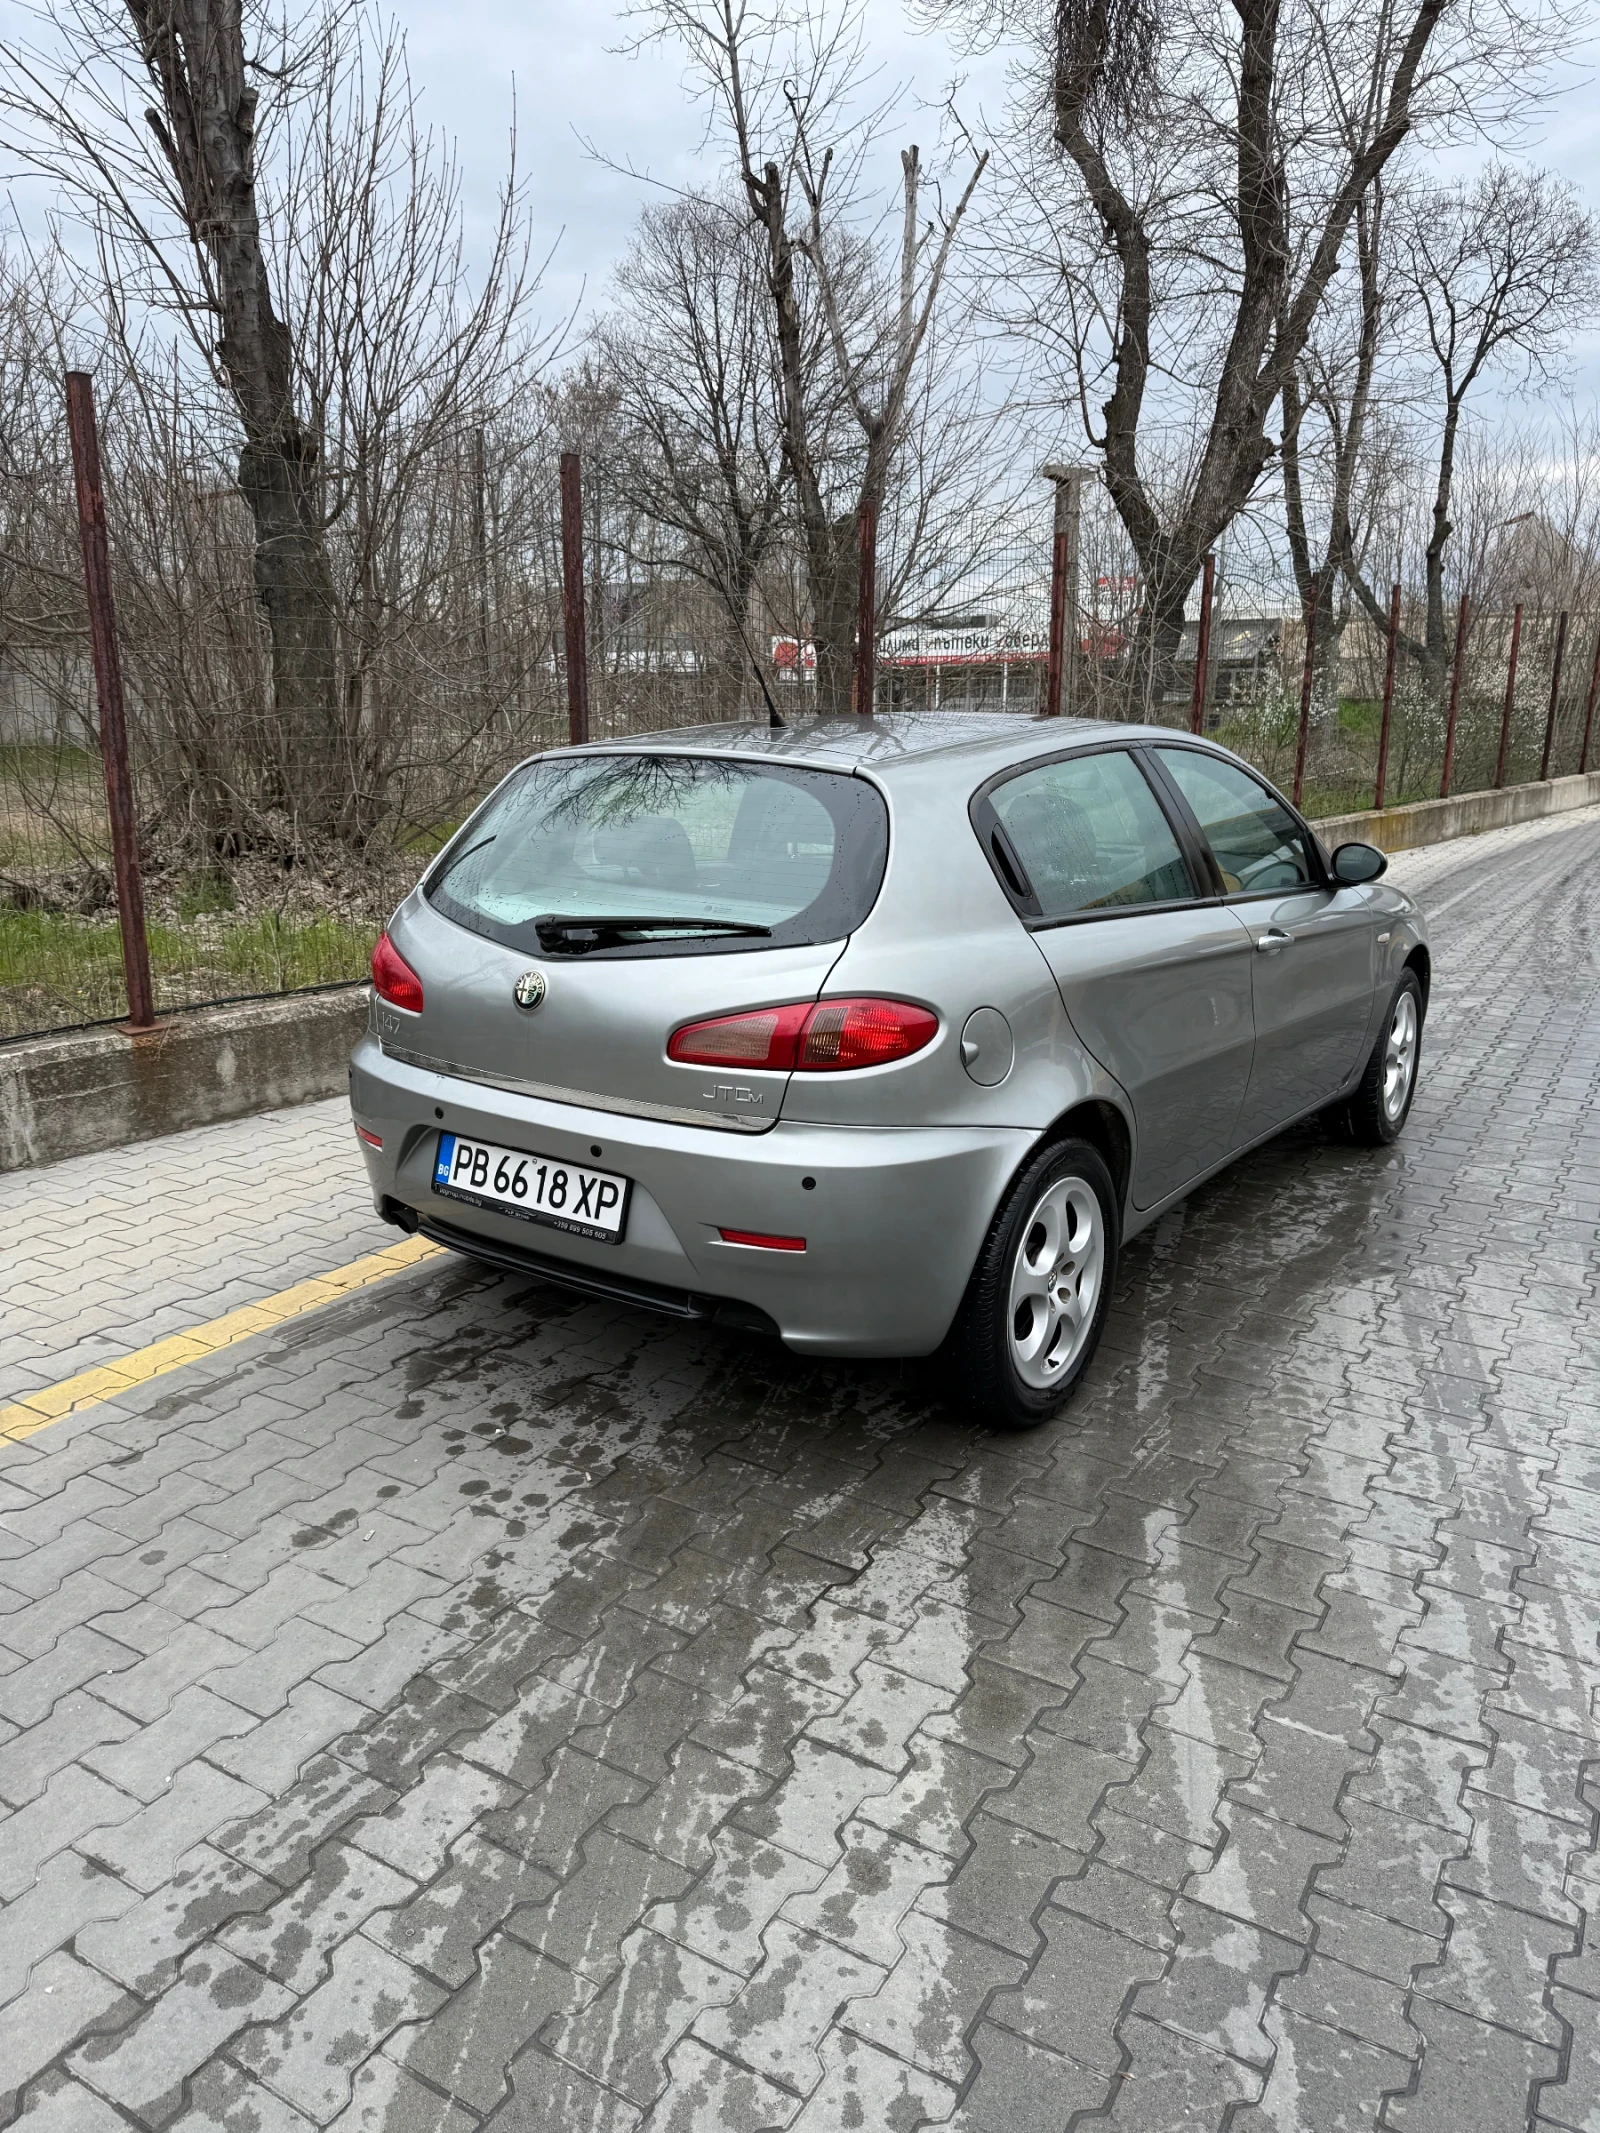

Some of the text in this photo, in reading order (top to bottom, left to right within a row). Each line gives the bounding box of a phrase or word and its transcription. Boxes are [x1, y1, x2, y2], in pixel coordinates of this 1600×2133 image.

[934, 633, 989, 650] пътеки
[382, 1011, 401, 1035] 147
[437, 1163, 450, 1177] BG
[553, 1220, 569, 1230] +359
